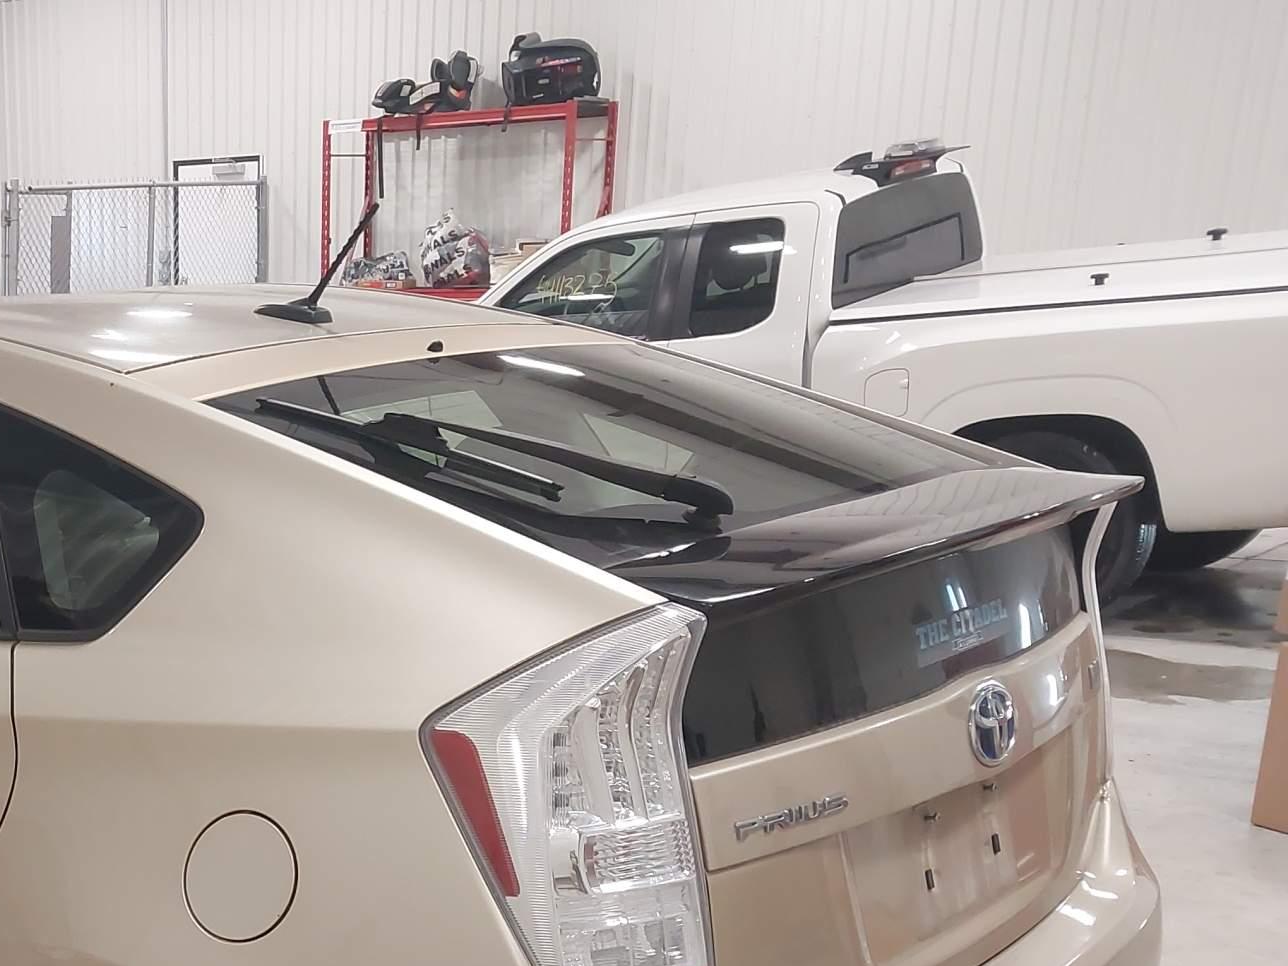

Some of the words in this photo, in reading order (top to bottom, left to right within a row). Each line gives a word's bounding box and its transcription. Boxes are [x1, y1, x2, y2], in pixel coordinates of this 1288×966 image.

[915, 618, 950, 650] THE
[951, 598, 1009, 637] CITADEL
[734, 793, 849, 842] PRIUS
